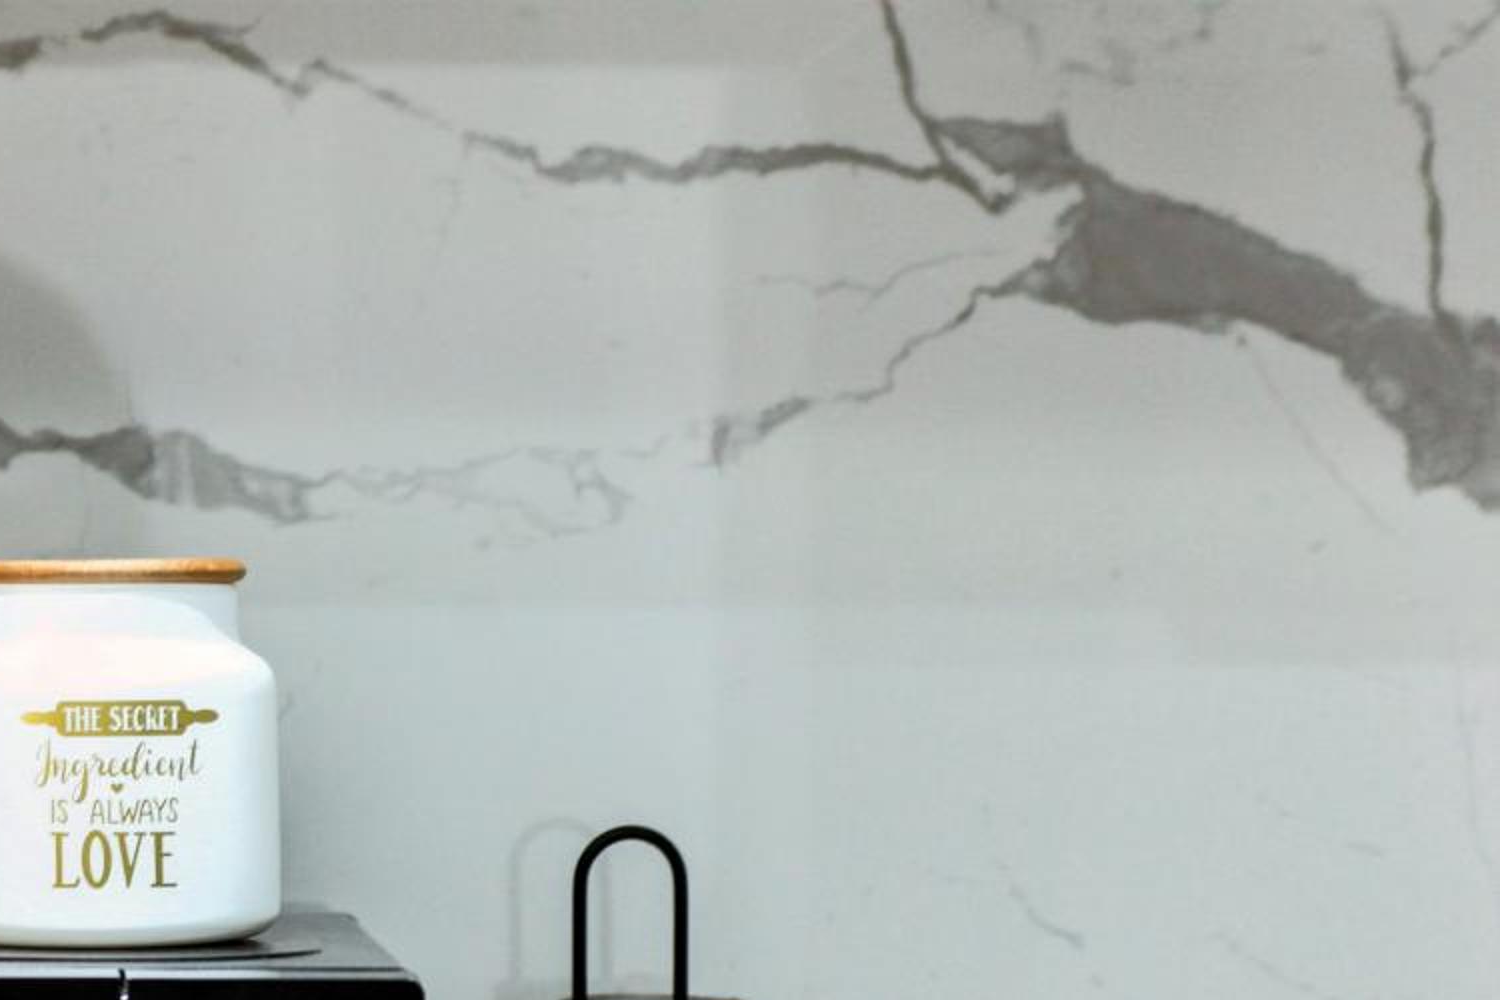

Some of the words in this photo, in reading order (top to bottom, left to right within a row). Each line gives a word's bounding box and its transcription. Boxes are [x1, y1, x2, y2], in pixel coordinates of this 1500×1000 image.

[64, 705, 102, 732] THE
[108, 705, 181, 731] SECRET
[35, 738, 202, 804] Ingredient
[51, 798, 69, 824] IS
[89, 796, 180, 825] ALWAYS
[51, 829, 178, 890] LOVE
